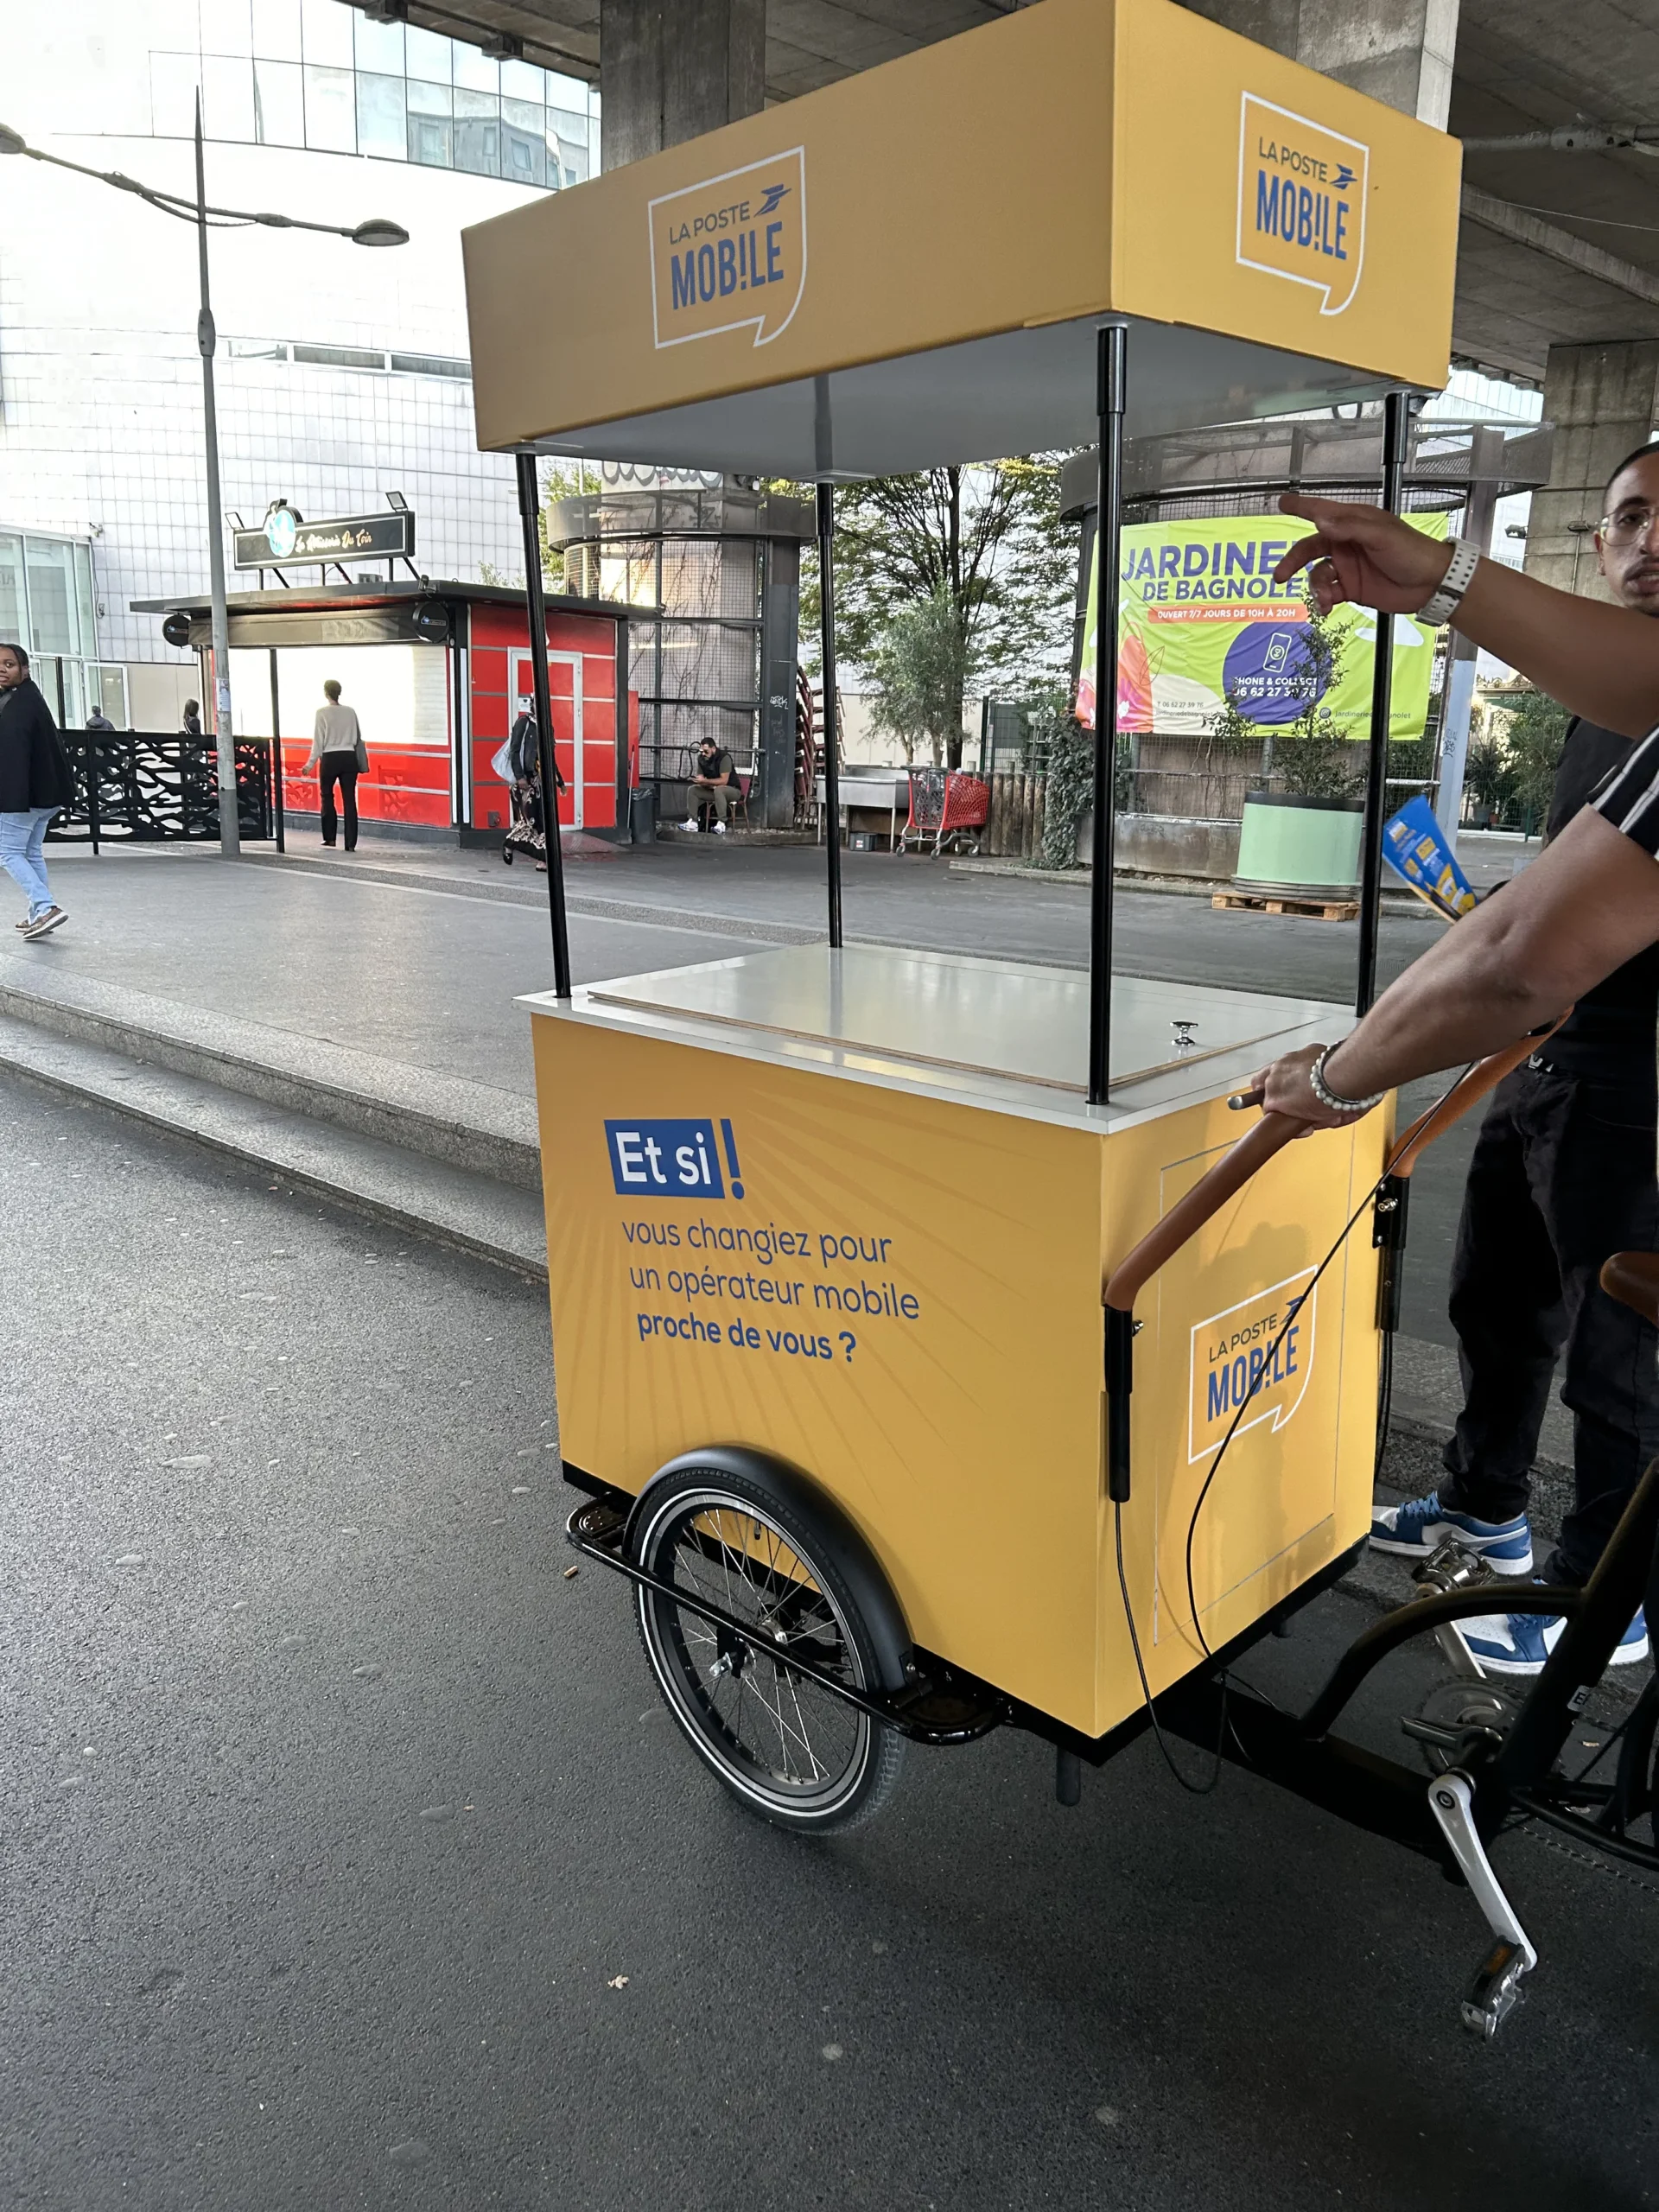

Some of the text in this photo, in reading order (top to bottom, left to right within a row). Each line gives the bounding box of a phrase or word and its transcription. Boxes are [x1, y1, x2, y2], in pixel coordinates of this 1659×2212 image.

[1259, 137, 1328, 182] LA POSTE
[669, 200, 750, 245] LA POSTE
[1122, 541, 1313, 581] JARDINE
[1142, 577, 1311, 601] DE BAGNOLE
[1158, 609, 1187, 619] OUVERT
[1189, 609, 1201, 620] 7/7
[1203, 608, 1231, 619] JOURS
[1234, 608, 1245, 618] DE
[1248, 608, 1264, 618] 10H
[1276, 607, 1296, 617] 20H
[1250, 687, 1265, 696] 62
[1267, 687, 1281, 696] 27
[615, 1131, 667, 1184] Et
[675, 1131, 712, 1185] si
[621, 1218, 892, 1268] vous changiez pour
[629, 1265, 919, 1319] un opérateur mobile
[637, 1312, 856, 1363] proche de vous ?
[1209, 1313, 1277, 1363] LA POSTE
